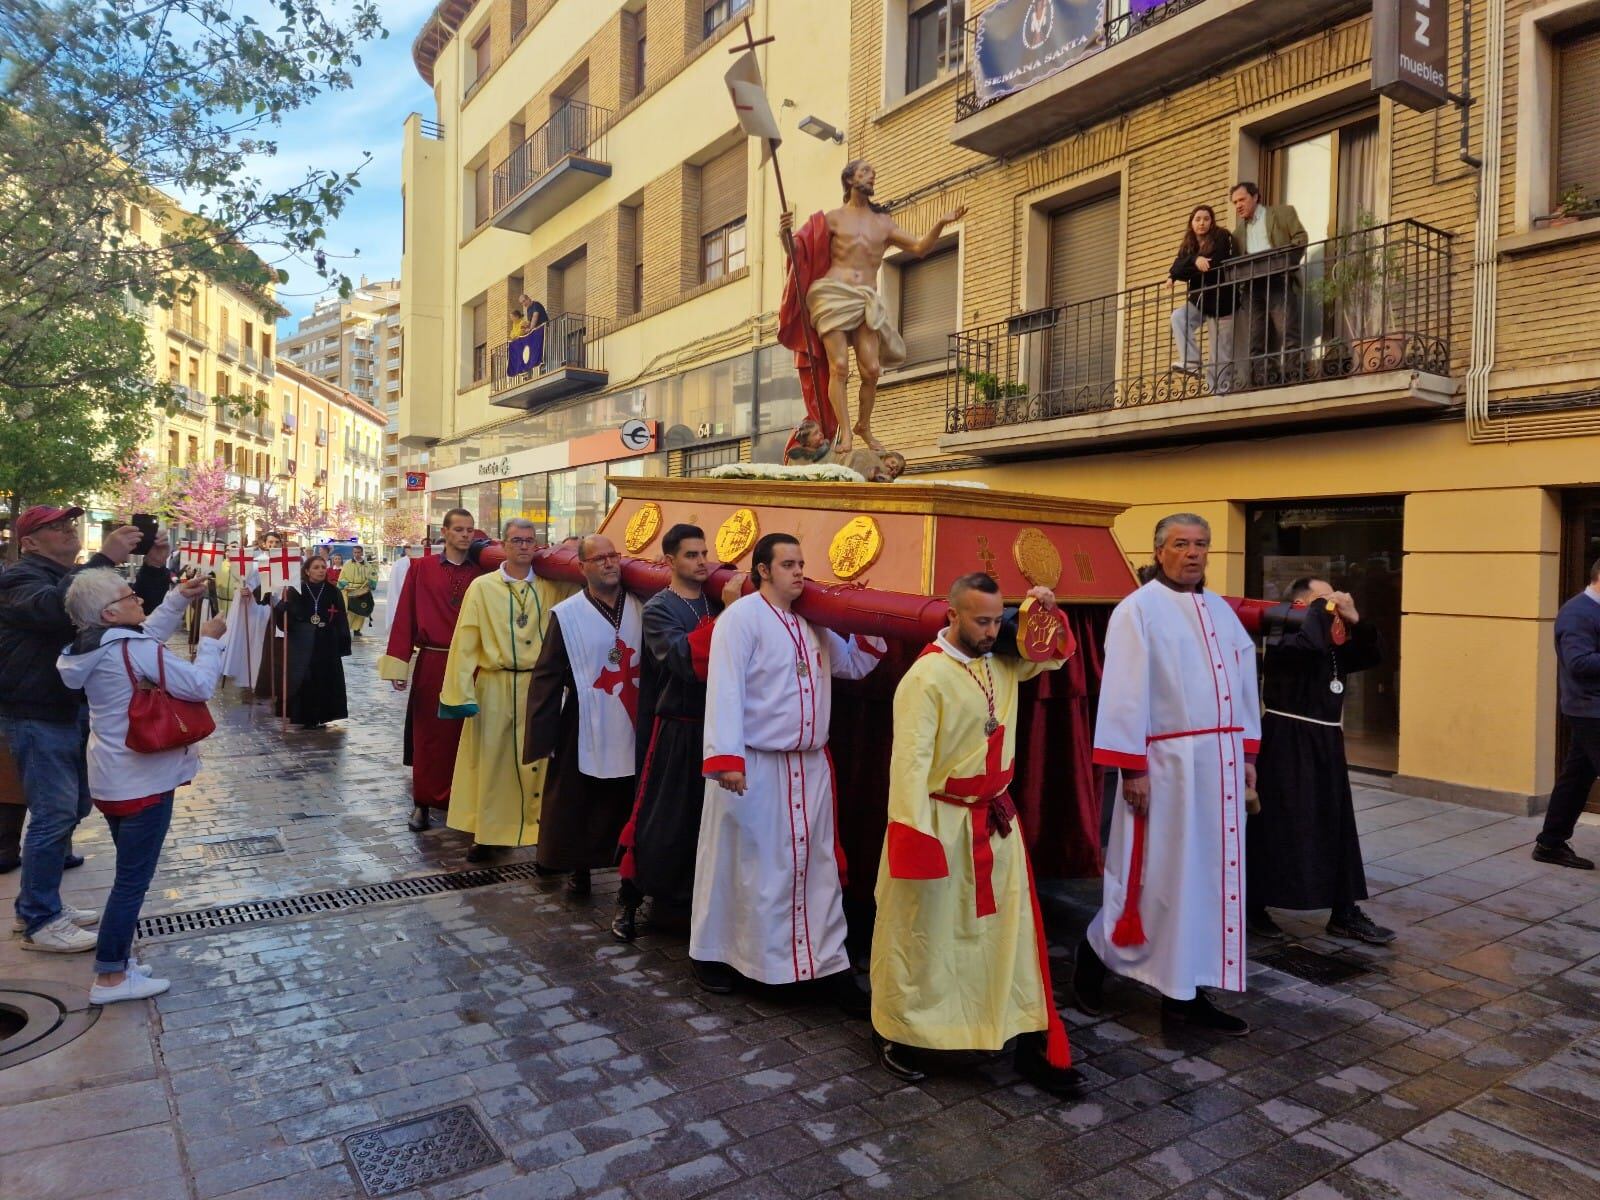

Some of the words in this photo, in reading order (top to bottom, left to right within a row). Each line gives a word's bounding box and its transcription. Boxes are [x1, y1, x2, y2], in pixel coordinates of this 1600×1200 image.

[983, 60, 1042, 87] SEMANA
[1044, 35, 1088, 63] SANTA
[1400, 55, 1444, 87] muebles
[697, 423, 710, 439] 64
